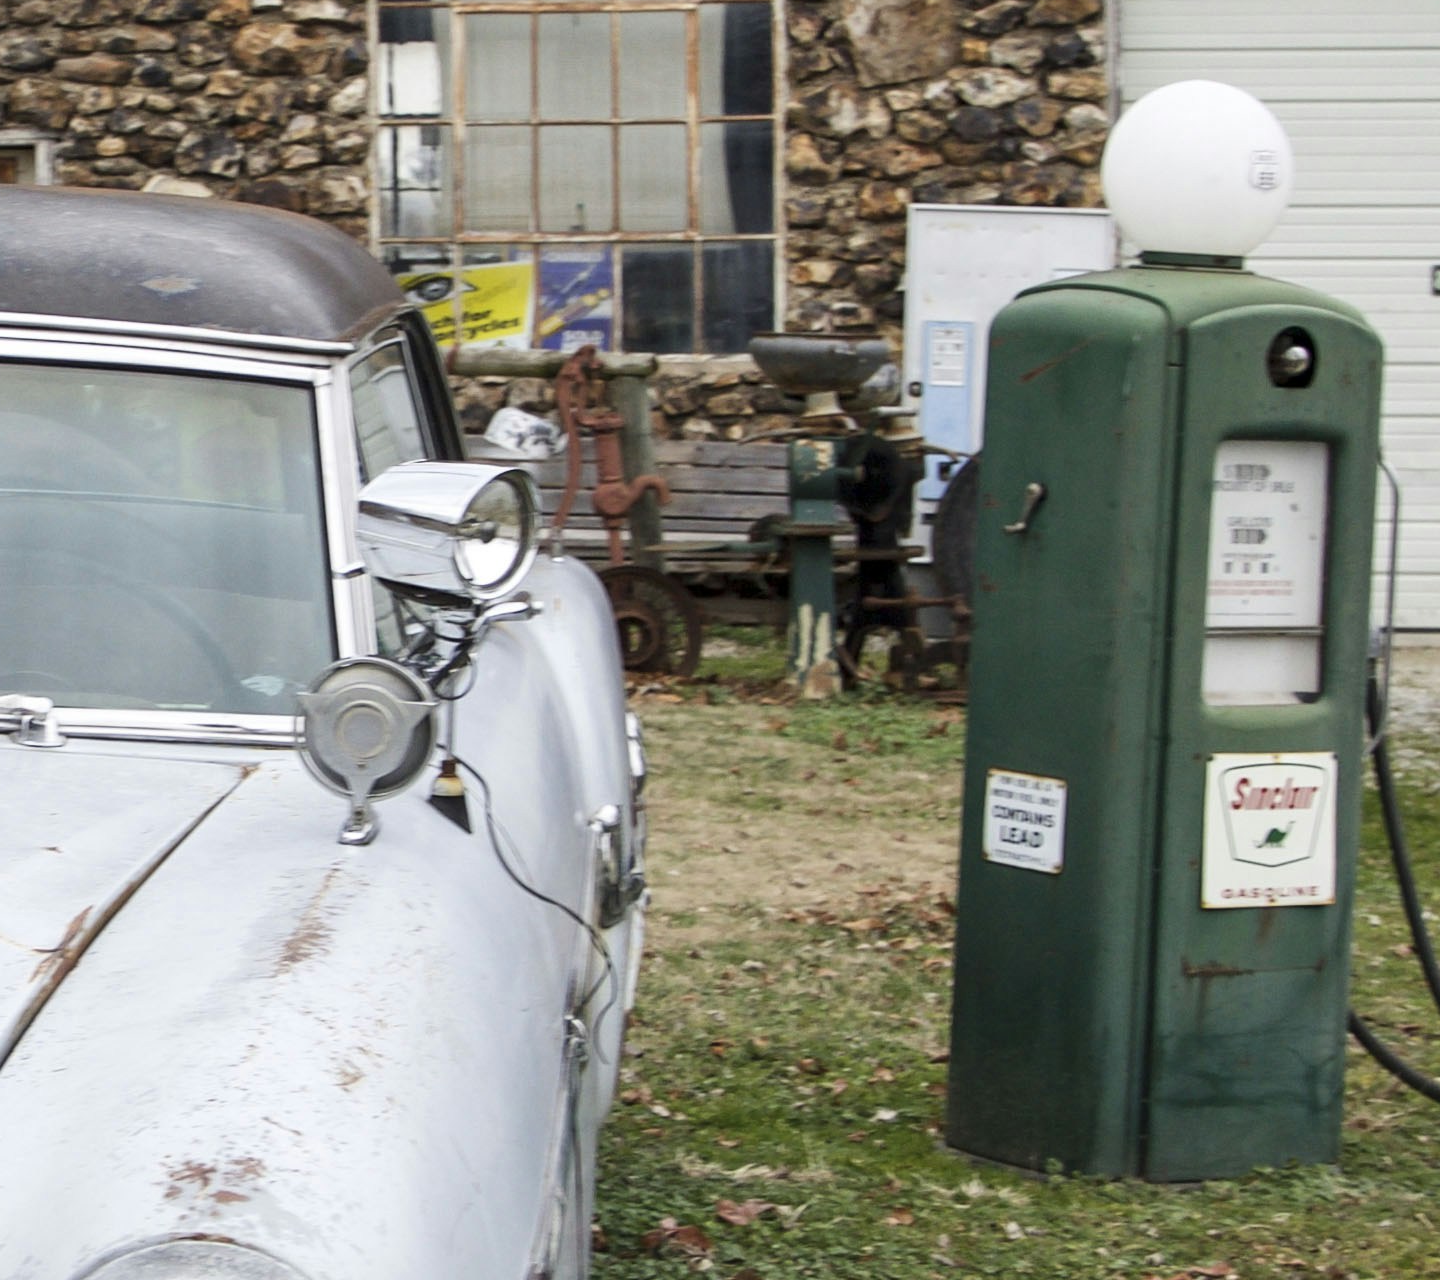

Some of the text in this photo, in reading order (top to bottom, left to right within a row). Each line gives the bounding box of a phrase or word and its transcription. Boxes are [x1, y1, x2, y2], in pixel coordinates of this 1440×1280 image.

[1229, 777, 1319, 810] Sinclair
[992, 804, 1056, 828] CONTAINS
[999, 825, 1046, 848] LEAD
[1221, 886, 1320, 899] GASOLINE
